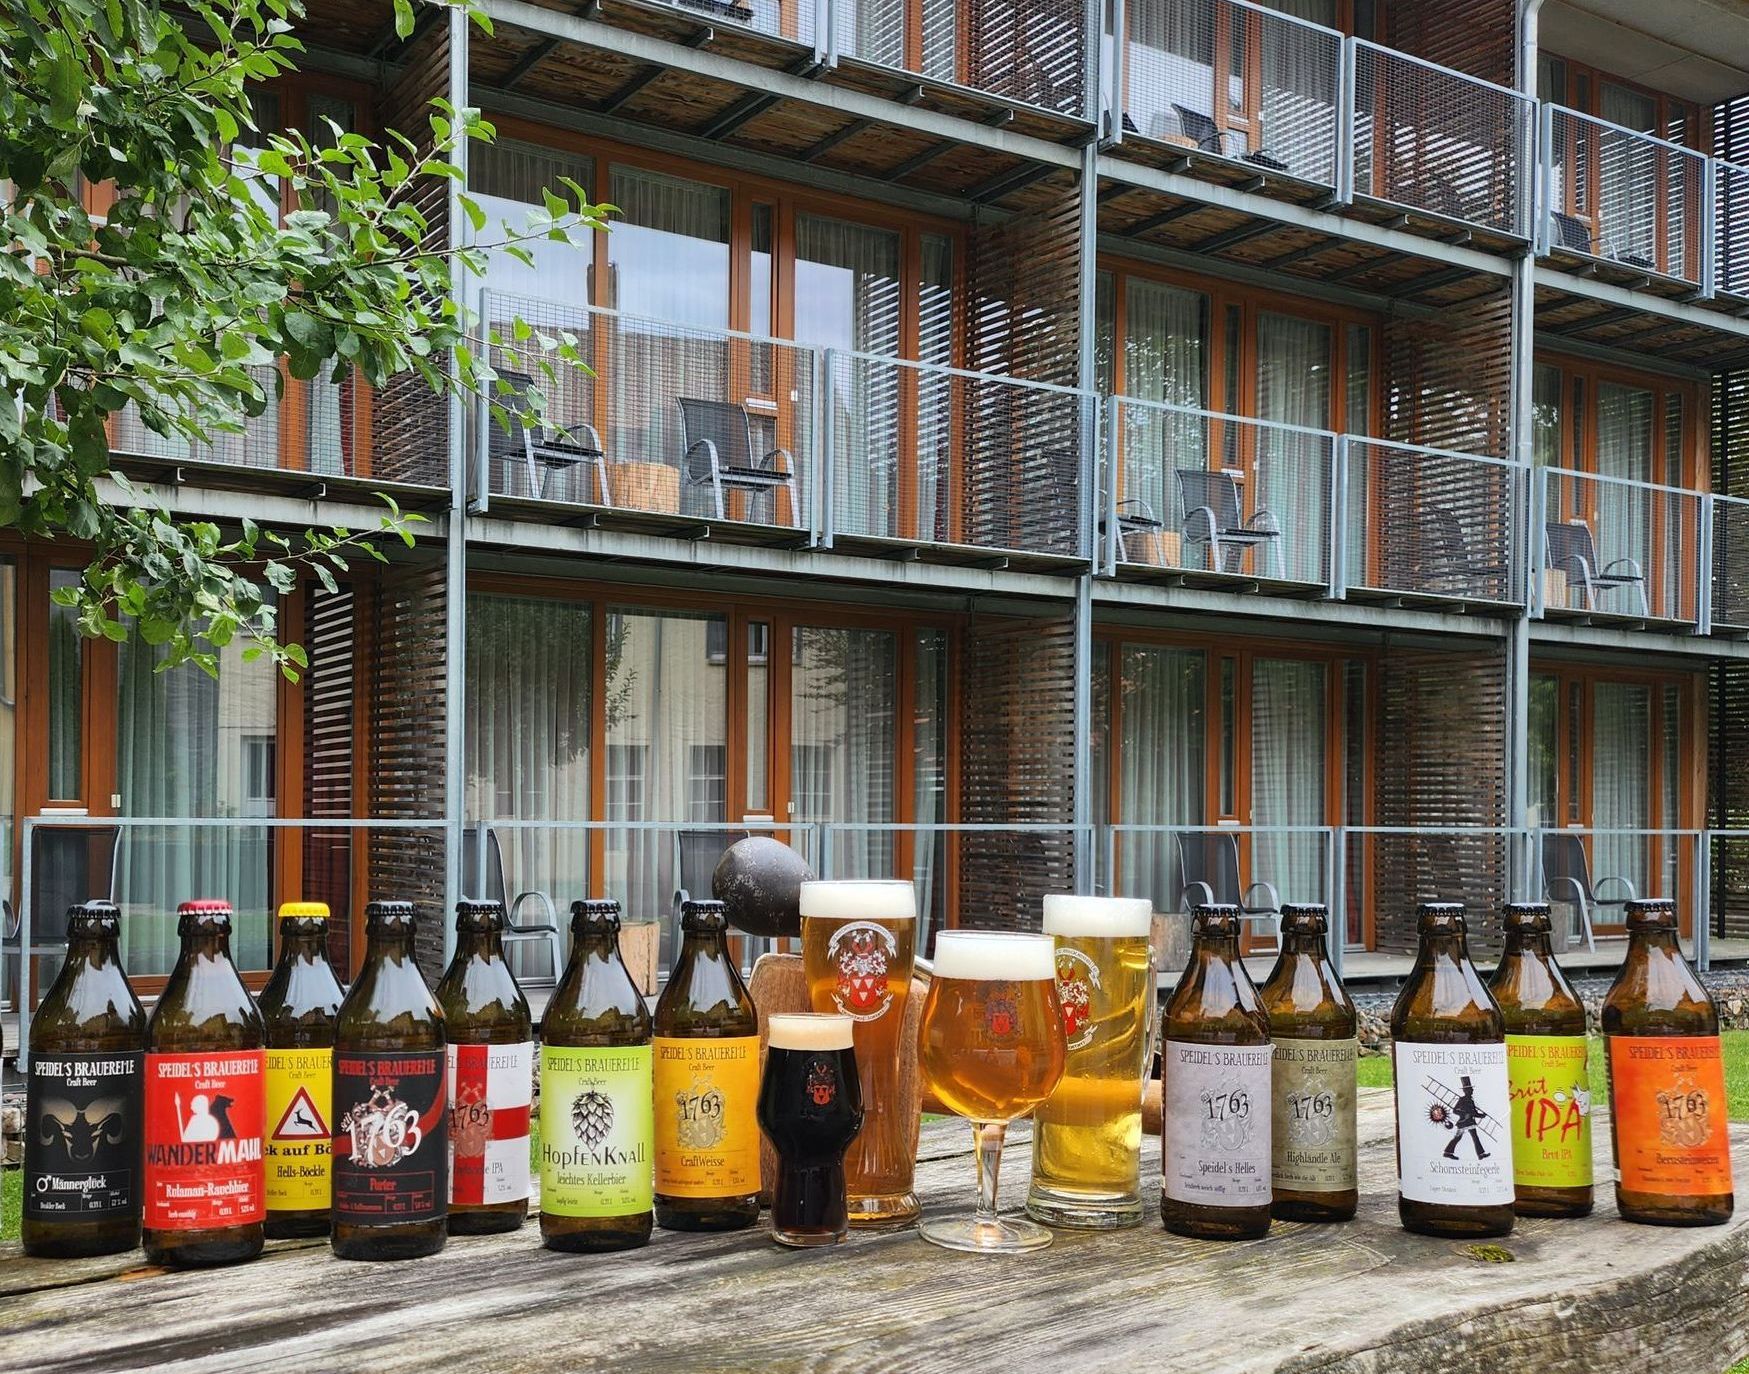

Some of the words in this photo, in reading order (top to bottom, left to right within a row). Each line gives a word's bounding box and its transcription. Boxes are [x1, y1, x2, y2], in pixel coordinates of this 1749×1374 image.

[296, 1055, 333, 1069] BRAUER
[1180, 1049, 1221, 1065] SPEIDEL'S
[1273, 1047, 1305, 1062] EIDEL'S
[1412, 1050, 1456, 1065] SPEIDEL'S
[34, 1061, 73, 1077] SPEIDEL'S
[158, 1062, 201, 1078] SPEIDEL'S
[547, 1056, 582, 1072] SPEIDEL'S
[688, 1063, 701, 1071] Craft
[702, 1063, 715, 1071] Beer
[66, 1077, 81, 1087] Craft
[82, 1077, 98, 1087] Beer
[194, 1080, 211, 1090] Craft
[211, 1079, 226, 1089] Beer
[681, 1091, 721, 1122] 1763
[1206, 1088, 1249, 1121] 1763
[1293, 1091, 1333, 1121] 1763
[449, 1099, 490, 1131] 1763
[1525, 1097, 1583, 1144] IPA
[346, 1103, 422, 1168] 1763
[282, 1144, 311, 1156] auf
[314, 1142, 333, 1156] Bö
[681, 1155, 725, 1167] CraftWeisse
[1330, 1151, 1342, 1163] Ale
[492, 1161, 504, 1175] IPA
[1198, 1160, 1233, 1176] Speidel's
[1235, 1161, 1256, 1174] Helles
[52, 1175, 107, 1193] Männerglück
[369, 1177, 398, 1192] Porter
[557, 1172, 585, 1186] leichtes
[586, 1172, 627, 1186] Kellerbier
